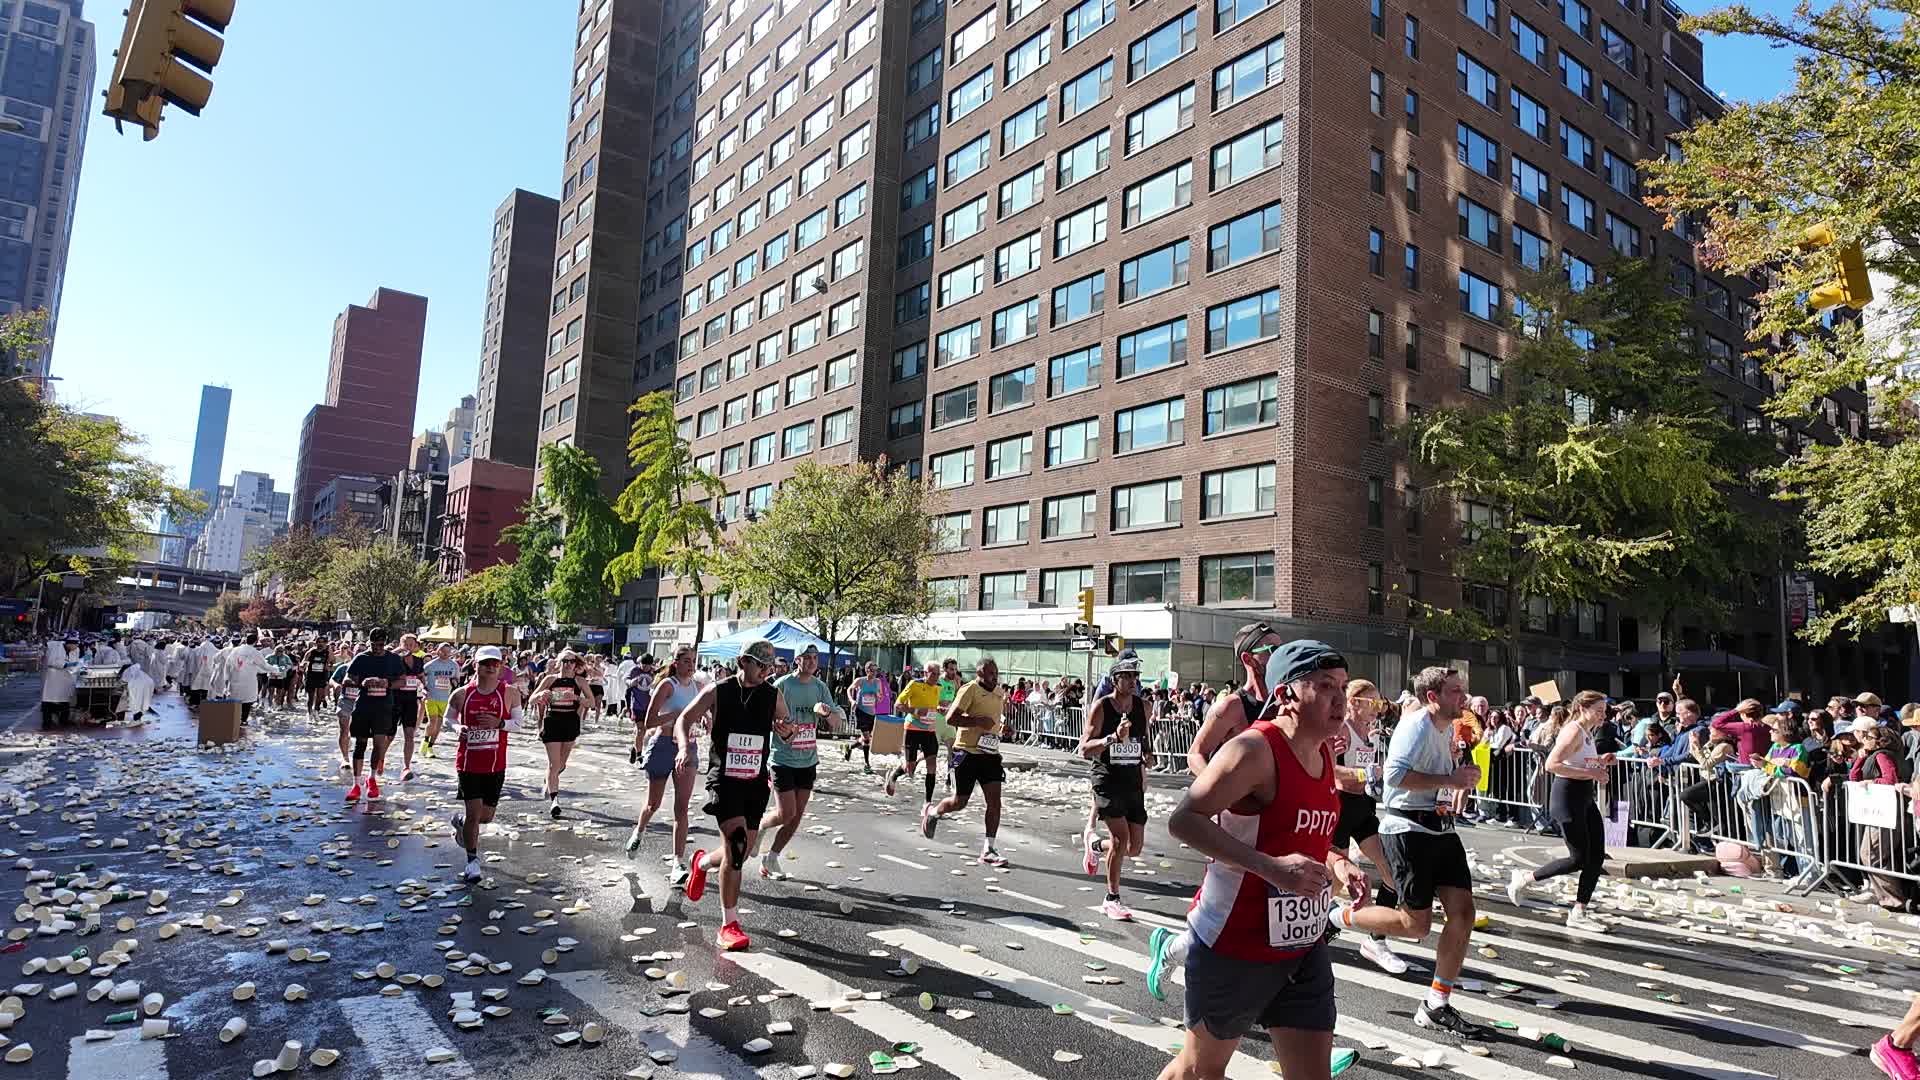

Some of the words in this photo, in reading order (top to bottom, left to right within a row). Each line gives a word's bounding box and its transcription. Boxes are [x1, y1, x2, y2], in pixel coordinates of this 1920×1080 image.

[469, 730, 497, 740] 26277
[730, 754, 760, 765] 19645
[1294, 809, 1337, 836] PPTC
[1274, 890, 1329, 922] 13900
